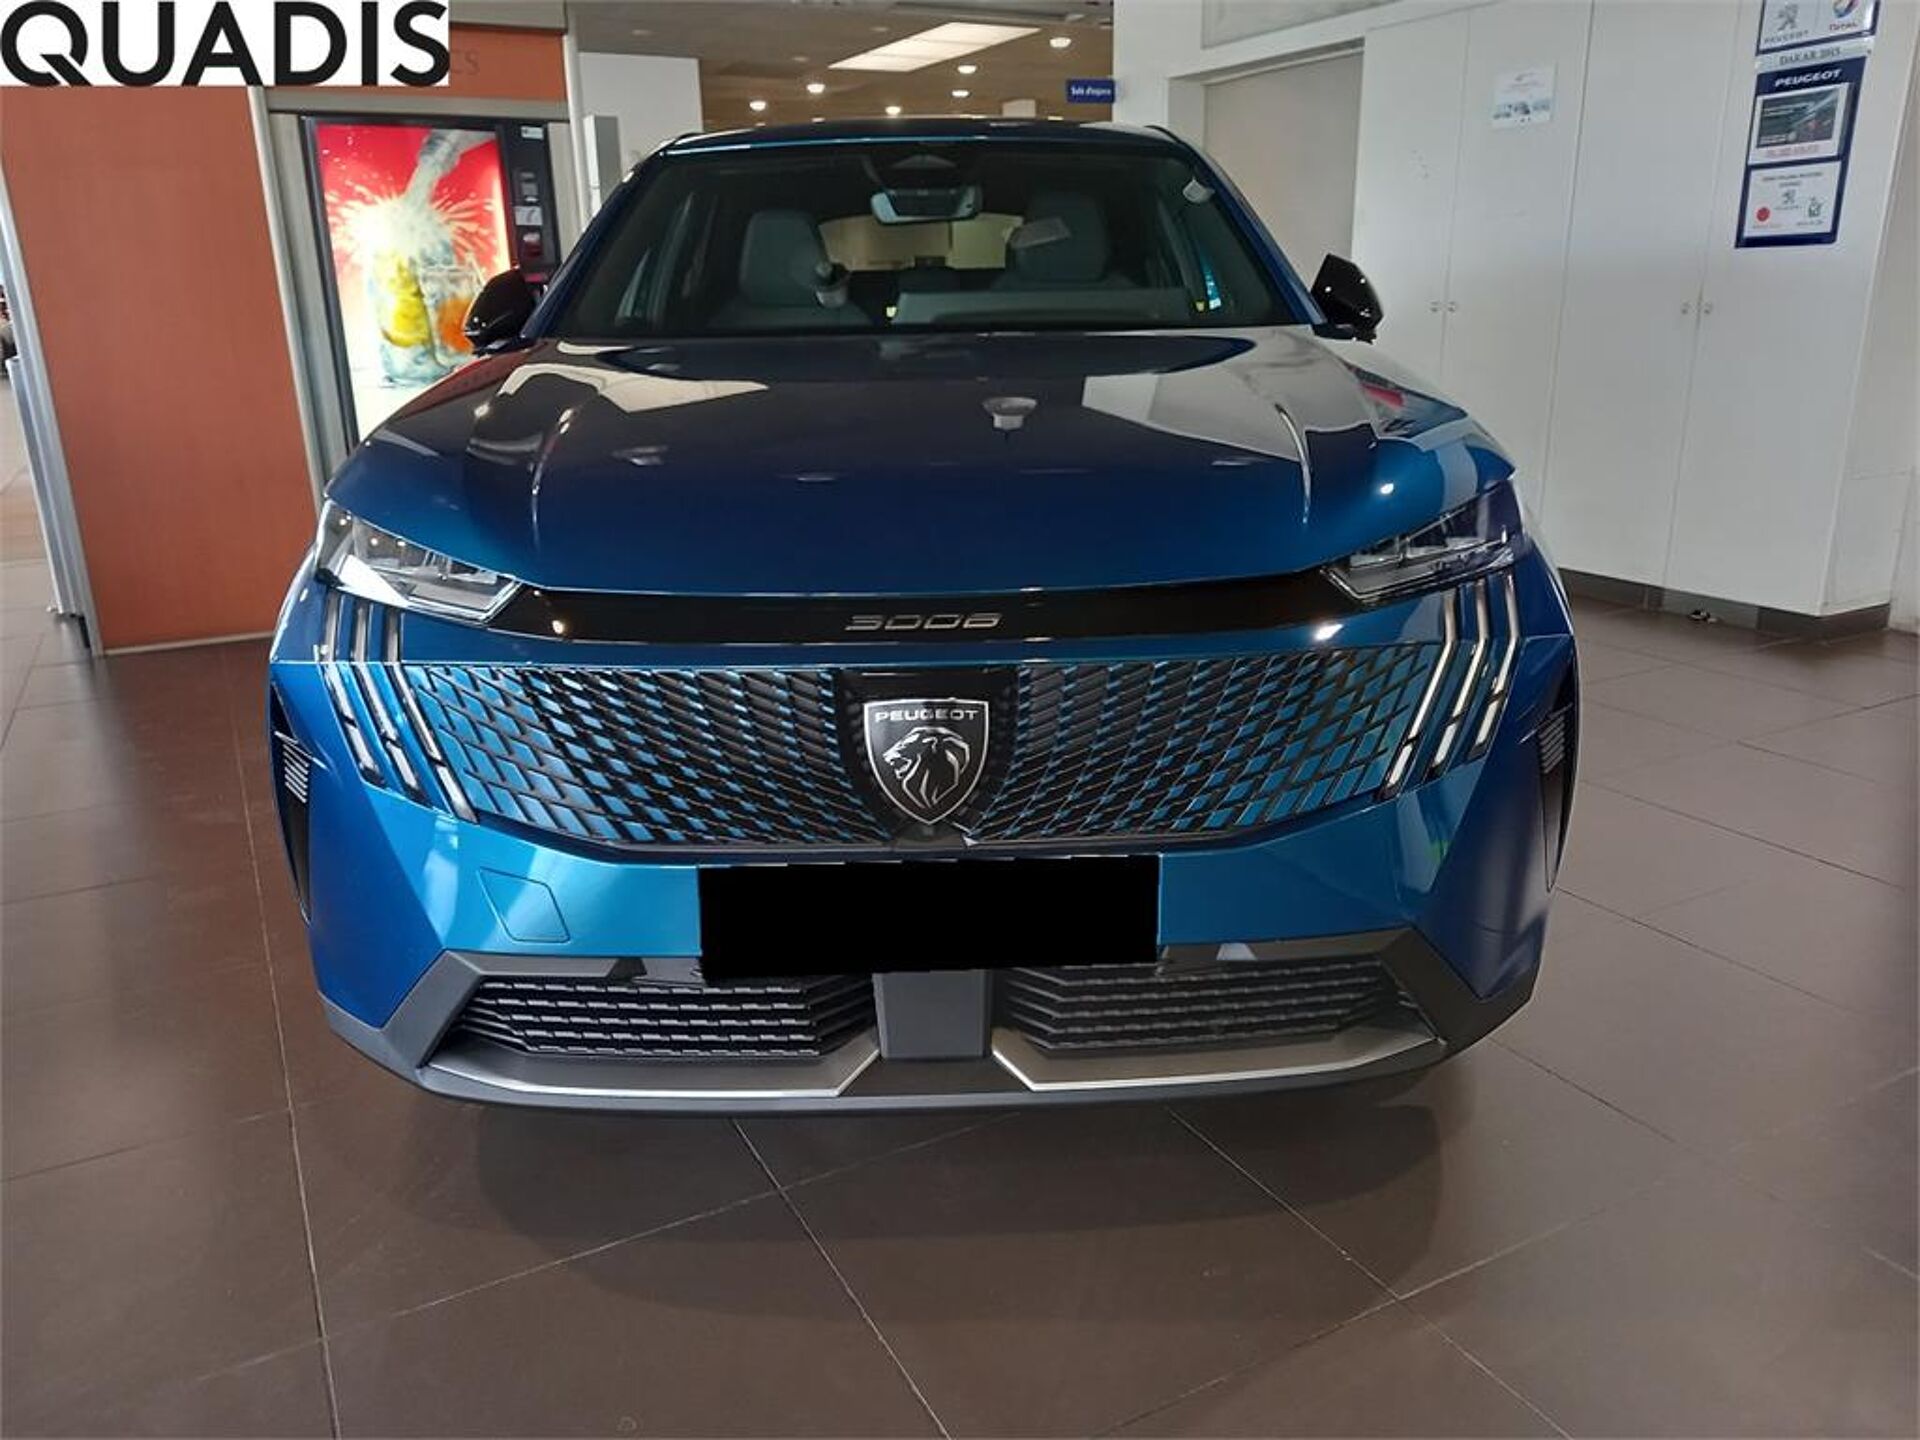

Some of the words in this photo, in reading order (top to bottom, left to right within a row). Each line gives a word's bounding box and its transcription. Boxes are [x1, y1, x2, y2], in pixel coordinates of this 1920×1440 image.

[1775, 69, 1842, 87] PEUGEOT
[845, 613, 1003, 631] 3008
[875, 709, 980, 722] PEUGEOT
